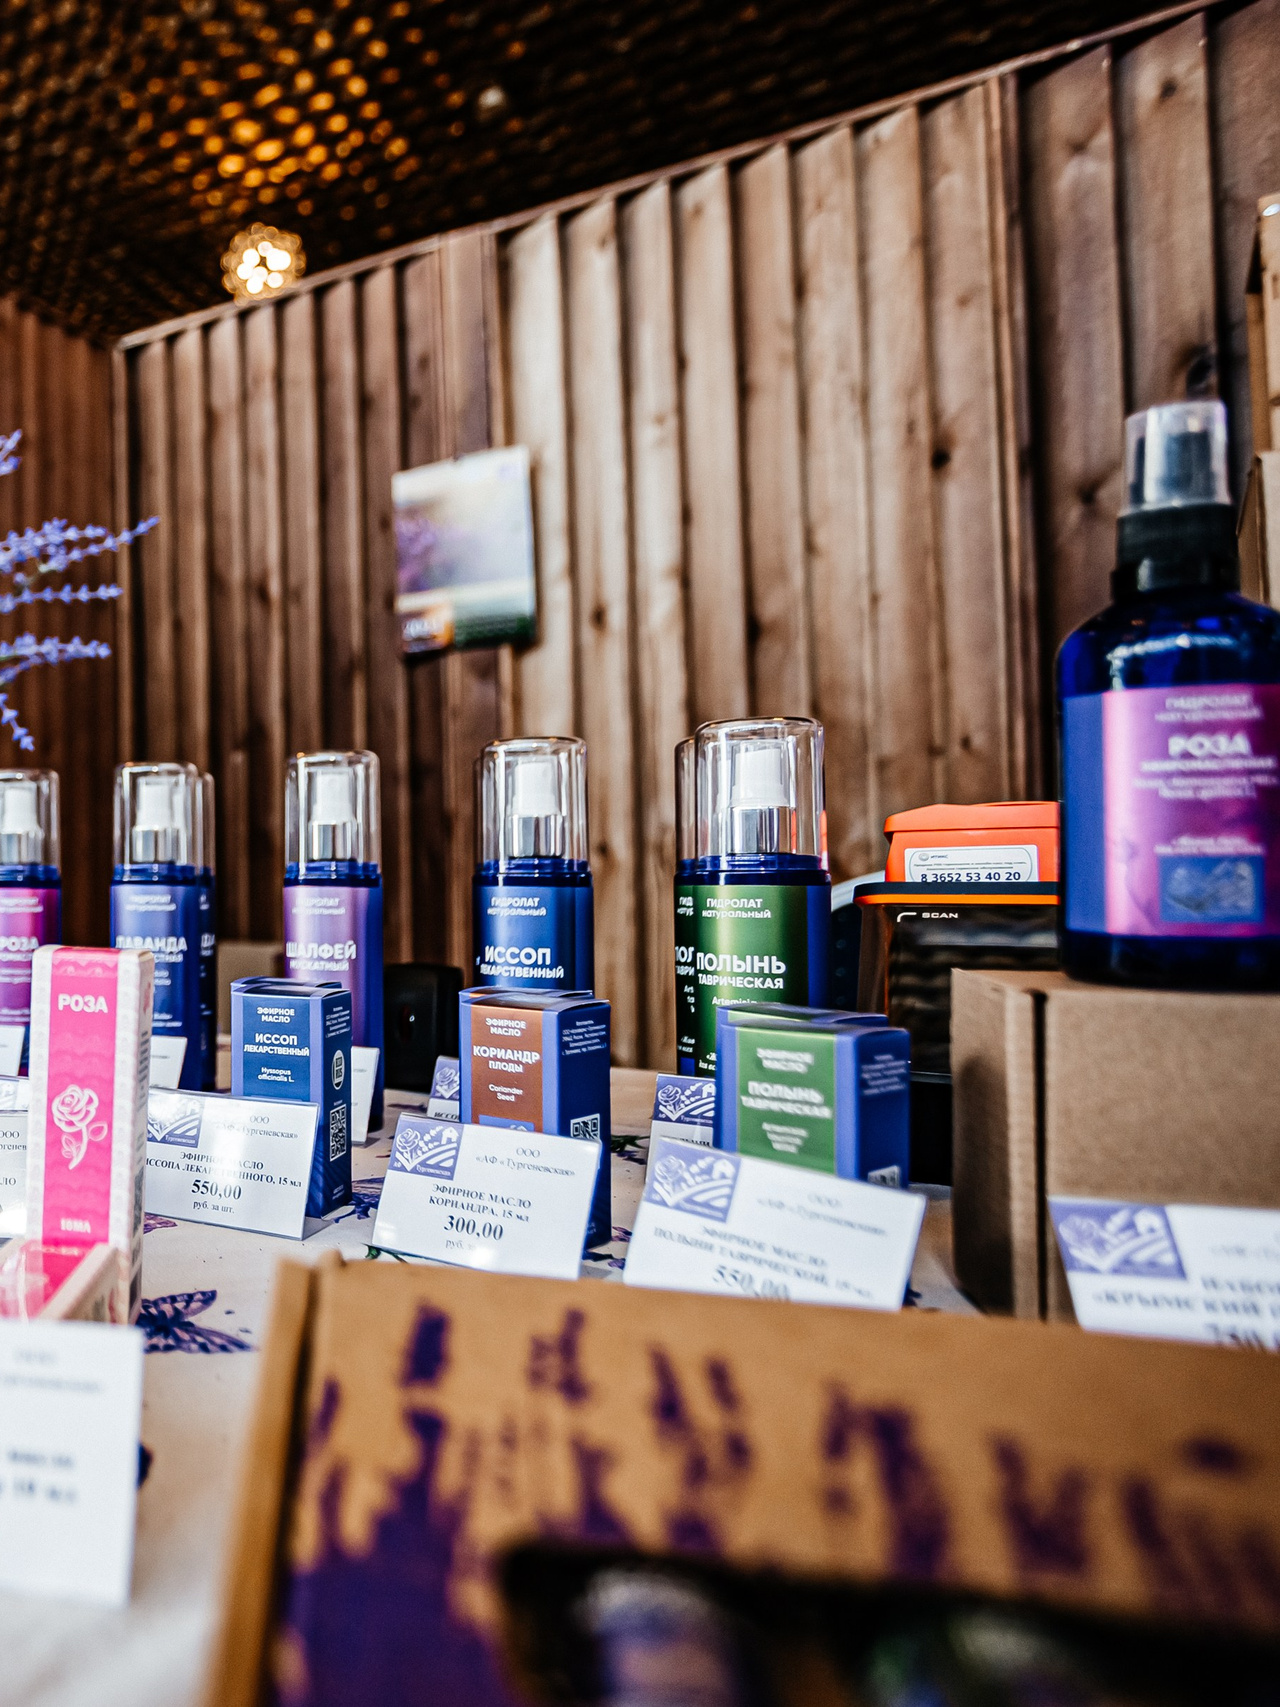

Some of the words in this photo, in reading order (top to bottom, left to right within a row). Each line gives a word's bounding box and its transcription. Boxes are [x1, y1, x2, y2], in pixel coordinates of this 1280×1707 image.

[1167, 732, 1253, 758] РОЗА
[920, 873, 928, 883] 8
[931, 872, 962, 883] 3652
[966, 872, 981, 881] 53
[985, 871, 1001, 881] 40
[1005, 871, 1021, 880] 20
[490, 896, 540, 908] ГИДРОЛАТ
[706, 897, 763, 909] ГИДРОЛАТ
[701, 909, 772, 919] натуральный
[115, 935, 188, 954] ЛАВАНДА
[285, 940, 357, 961] ШАЛФЕЙ
[484, 945, 551, 966] ИССОП
[696, 951, 786, 975] ПОЛЫНЬ
[697, 973, 784, 990] ТАВРИЧЕСКАЯ
[58, 993, 108, 1013] РОЗА
[711, 995, 758, 1006] Artemii
[256, 1006, 295, 1017] ЭФИРНОЕ
[261, 1014, 291, 1024] МАСЛО
[484, 1017, 526, 1029] ЭФИРНОЕ
[489, 1025, 521, 1037] МАСЛО
[255, 1032, 298, 1046] ИССОП
[243, 1044, 310, 1058] ЛЕКАРСТВЕННЫЙ
[472, 1044, 540, 1064] КОРИАНДР
[260, 1066, 292, 1077] Hyssopus
[488, 1060, 523, 1073] ПЛОДЫ
[257, 1072, 287, 1082] officinalis
[287, 1074, 295, 1083] L.
[488, 1083, 523, 1096] Coriander
[496, 1091, 515, 1102] Seed
[249, 1115, 270, 1125] ООО
[515, 1147, 541, 1158] ООО
[228, 1157, 264, 1170] АСЛО
[278, 1176, 289, 1186] 15
[290, 1180, 302, 1188] мл
[191, 1179, 242, 1201] 550,00
[432, 1183, 485, 1201] ЭФИРНОЕ
[488, 1193, 532, 1209] МАСЛО
[193, 1200, 210, 1211] руб.
[220, 1205, 235, 1214] шт.
[428, 1195, 498, 1217] КОРИАНДРА,
[501, 1209, 513, 1219] 15
[515, 1212, 530, 1223] мл
[60, 1218, 91, 1234] 10МЛ
[443, 1215, 504, 1241] 300,00
[445, 1239, 464, 1250] руб.
[712, 1263, 791, 1301] 550,00
